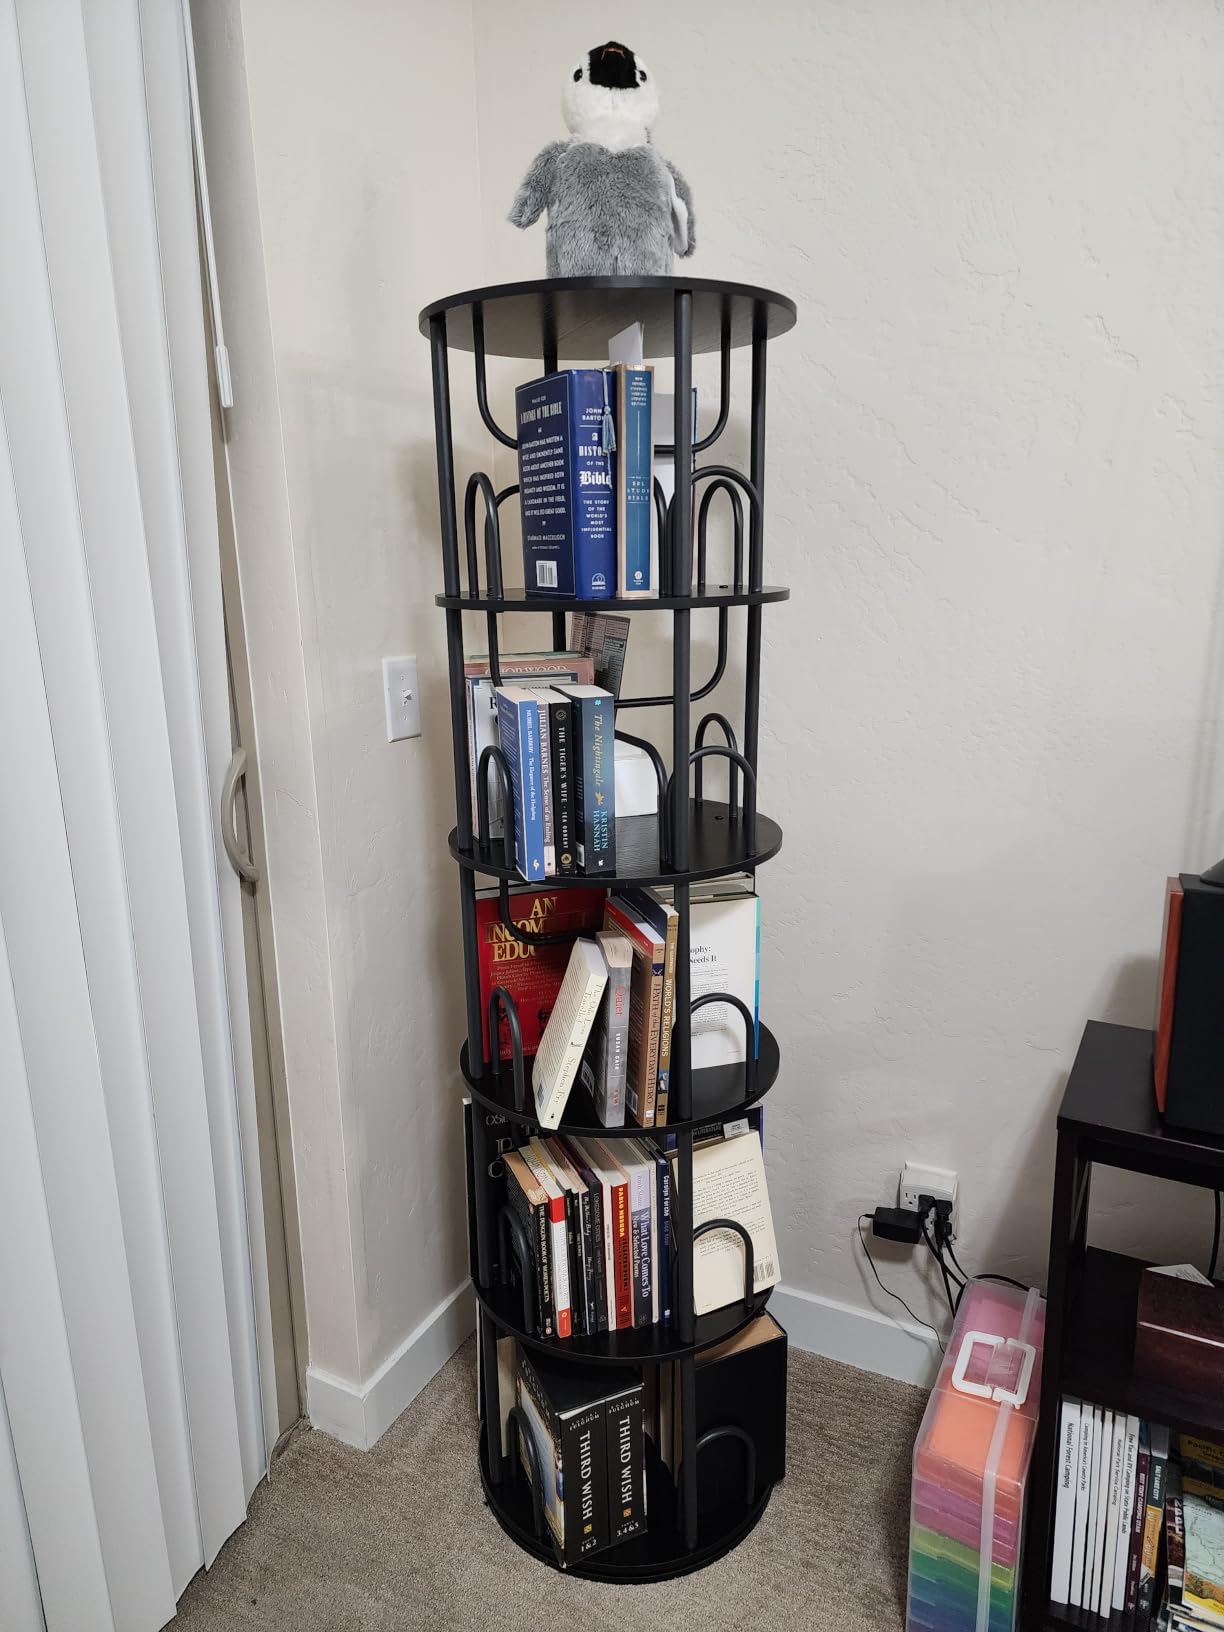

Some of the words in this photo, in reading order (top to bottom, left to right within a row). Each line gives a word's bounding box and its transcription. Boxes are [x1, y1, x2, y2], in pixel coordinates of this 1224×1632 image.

[542, 404, 550, 418] THE
[550, 401, 562, 416] BIBLE
[554, 446, 563, 454] SANE
[540, 461, 554, 469] ANOTHER
[579, 471, 611, 487] Bible
[538, 710, 546, 739] JULIAN
[594, 714, 603, 732] The
[558, 726, 566, 744] THE
[540, 742, 548, 774] BARNES
[593, 734, 604, 786] Nightingale
[545, 814, 550, 822] an
[544, 822, 552, 843] Ending
[530, 897, 558, 918] AN
[592, 983, 603, 998] The
[614, 986, 628, 1016] Quiet
[652, 988, 661, 1010] PATH
[664, 979, 673, 1013] WORLD'S
[576, 992, 592, 1023] Travelled
[586, 1000, 599, 1016] Ode
[662, 1016, 671, 1057] RELIGIONS
[649, 1029, 658, 1078] EVERYDAY
[559, 1056, 576, 1088] Stephen
[552, 1090, 566, 1104] Fry
[647, 1078, 655, 1104] HERO
[662, 1175, 670, 1196] Carolyn
[640, 1211, 650, 1236] What
[641, 1237, 650, 1256] Love
[542, 1256, 548, 1264] OF
[641, 1257, 650, 1286] Comes
[642, 1286, 651, 1298] To
[619, 1416, 631, 1463] THIRD
[1066, 1423, 1074, 1446] National
[580, 1430, 592, 1479] THIRD
[621, 1465, 632, 1503] WISH
[1064, 1464, 1072, 1488] Camping
[1124, 1469, 1132, 1488] Camping
[581, 1481, 592, 1520] WISH
[586, 1542, 592, 1550] &
[593, 1539, 598, 1547] 2
